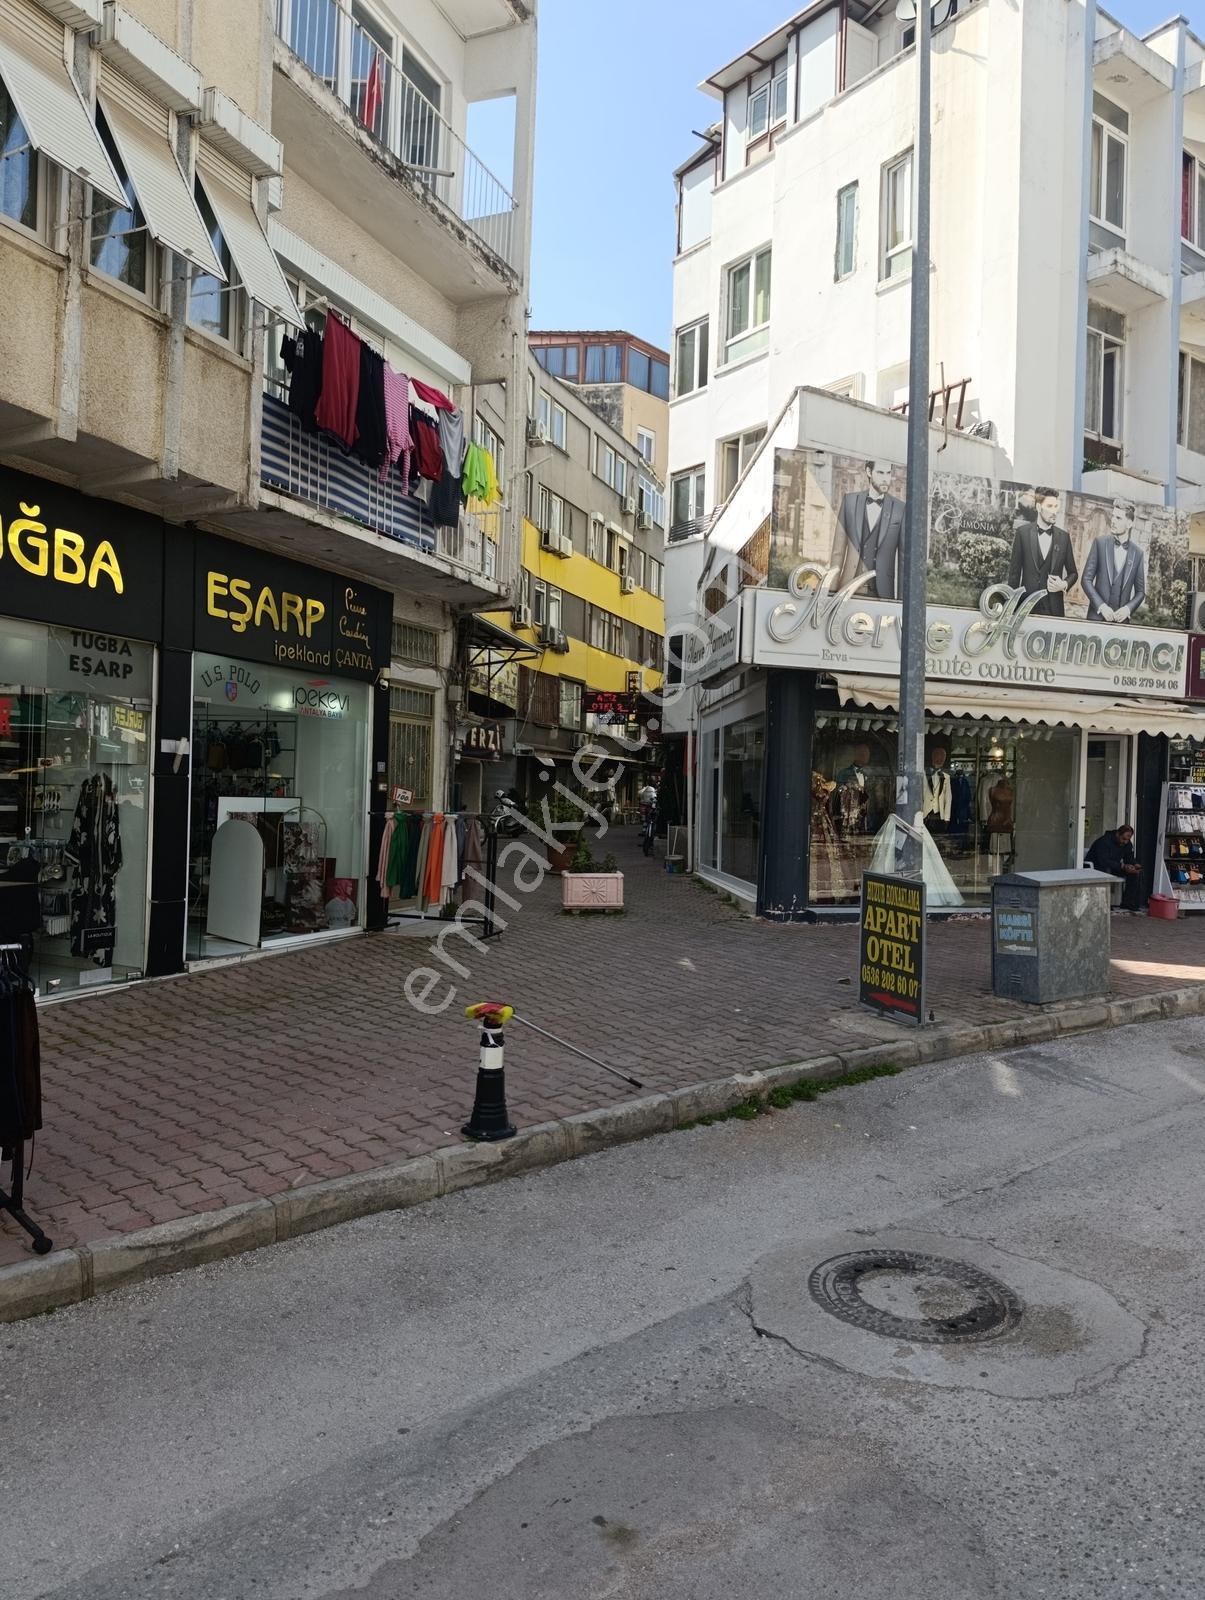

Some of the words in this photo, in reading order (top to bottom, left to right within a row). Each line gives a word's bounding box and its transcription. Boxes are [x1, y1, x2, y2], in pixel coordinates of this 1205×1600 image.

[0, 501, 124, 594] ĞBA
[207, 570, 325, 638] EŞARP
[69, 654, 133, 679] EŞARP
[274, 640, 330, 666] ipekland
[335, 648, 373, 670] ÇANTA
[821, 649, 848, 662] Erva
[230, 665, 260, 694] POLO
[925, 655, 972, 677] aute
[978, 660, 1056, 684] couture
[1139, 678, 1154, 688] 279
[292, 685, 350, 711] ipekevi
[863, 904, 921, 943] APART
[867, 935, 915, 974] OTEL
